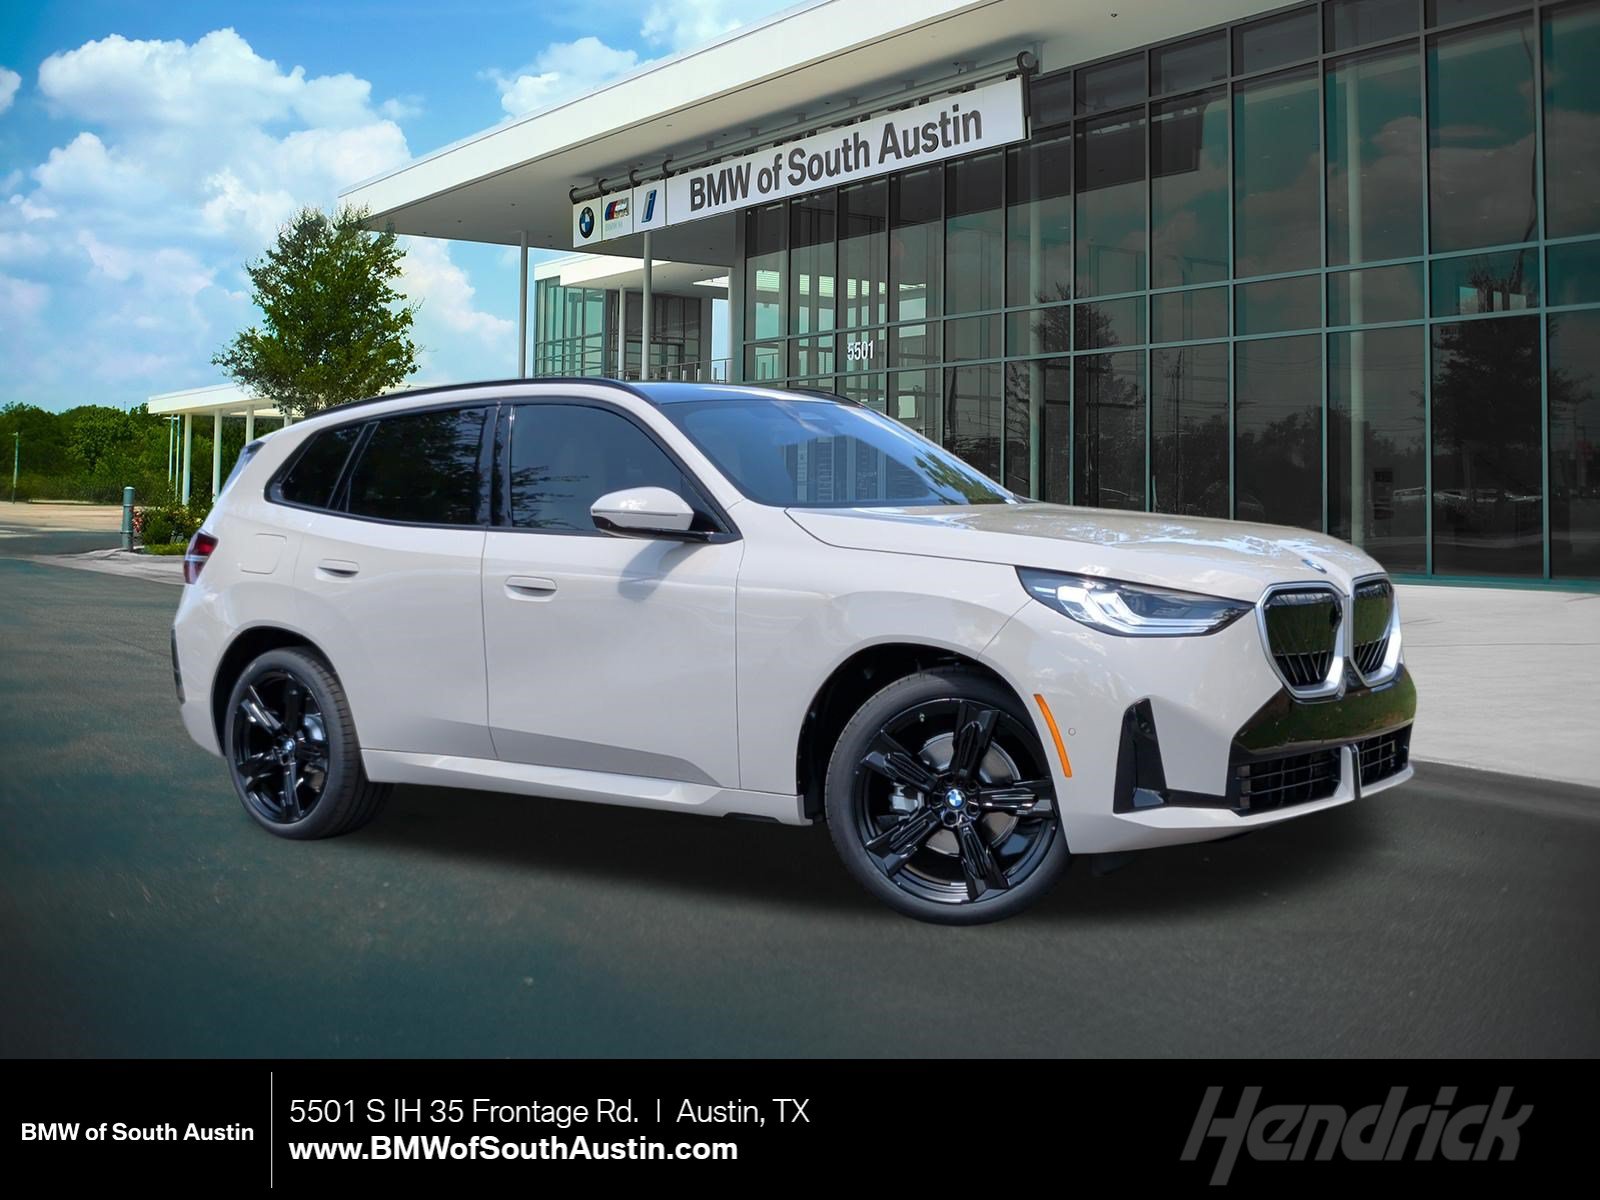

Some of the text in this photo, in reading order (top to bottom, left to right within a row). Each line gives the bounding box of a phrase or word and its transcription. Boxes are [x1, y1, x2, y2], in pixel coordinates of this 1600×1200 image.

[689, 103, 982, 212] BMW of South Austin
[847, 340, 873, 361] 5501
